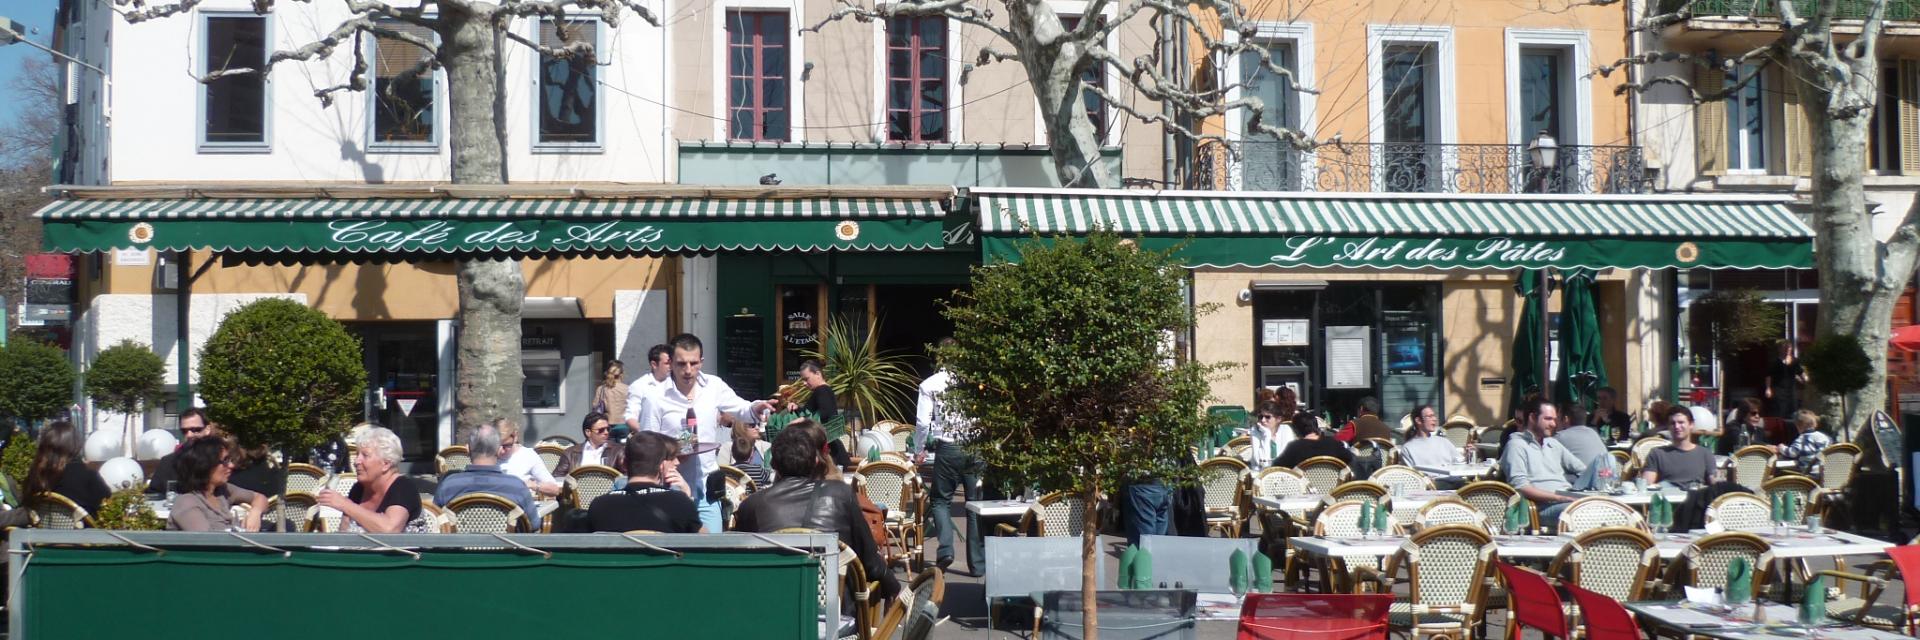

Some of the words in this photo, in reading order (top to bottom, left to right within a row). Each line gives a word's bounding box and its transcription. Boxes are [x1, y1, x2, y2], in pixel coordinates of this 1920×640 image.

[328, 218, 455, 250] Café
[464, 221, 539, 245] des
[552, 219, 664, 245] Arts
[942, 221, 974, 245] Ar
[1405, 238, 1457, 261] des
[1466, 236, 1566, 261] Pâtes
[787, 311, 812, 320] SALLE
